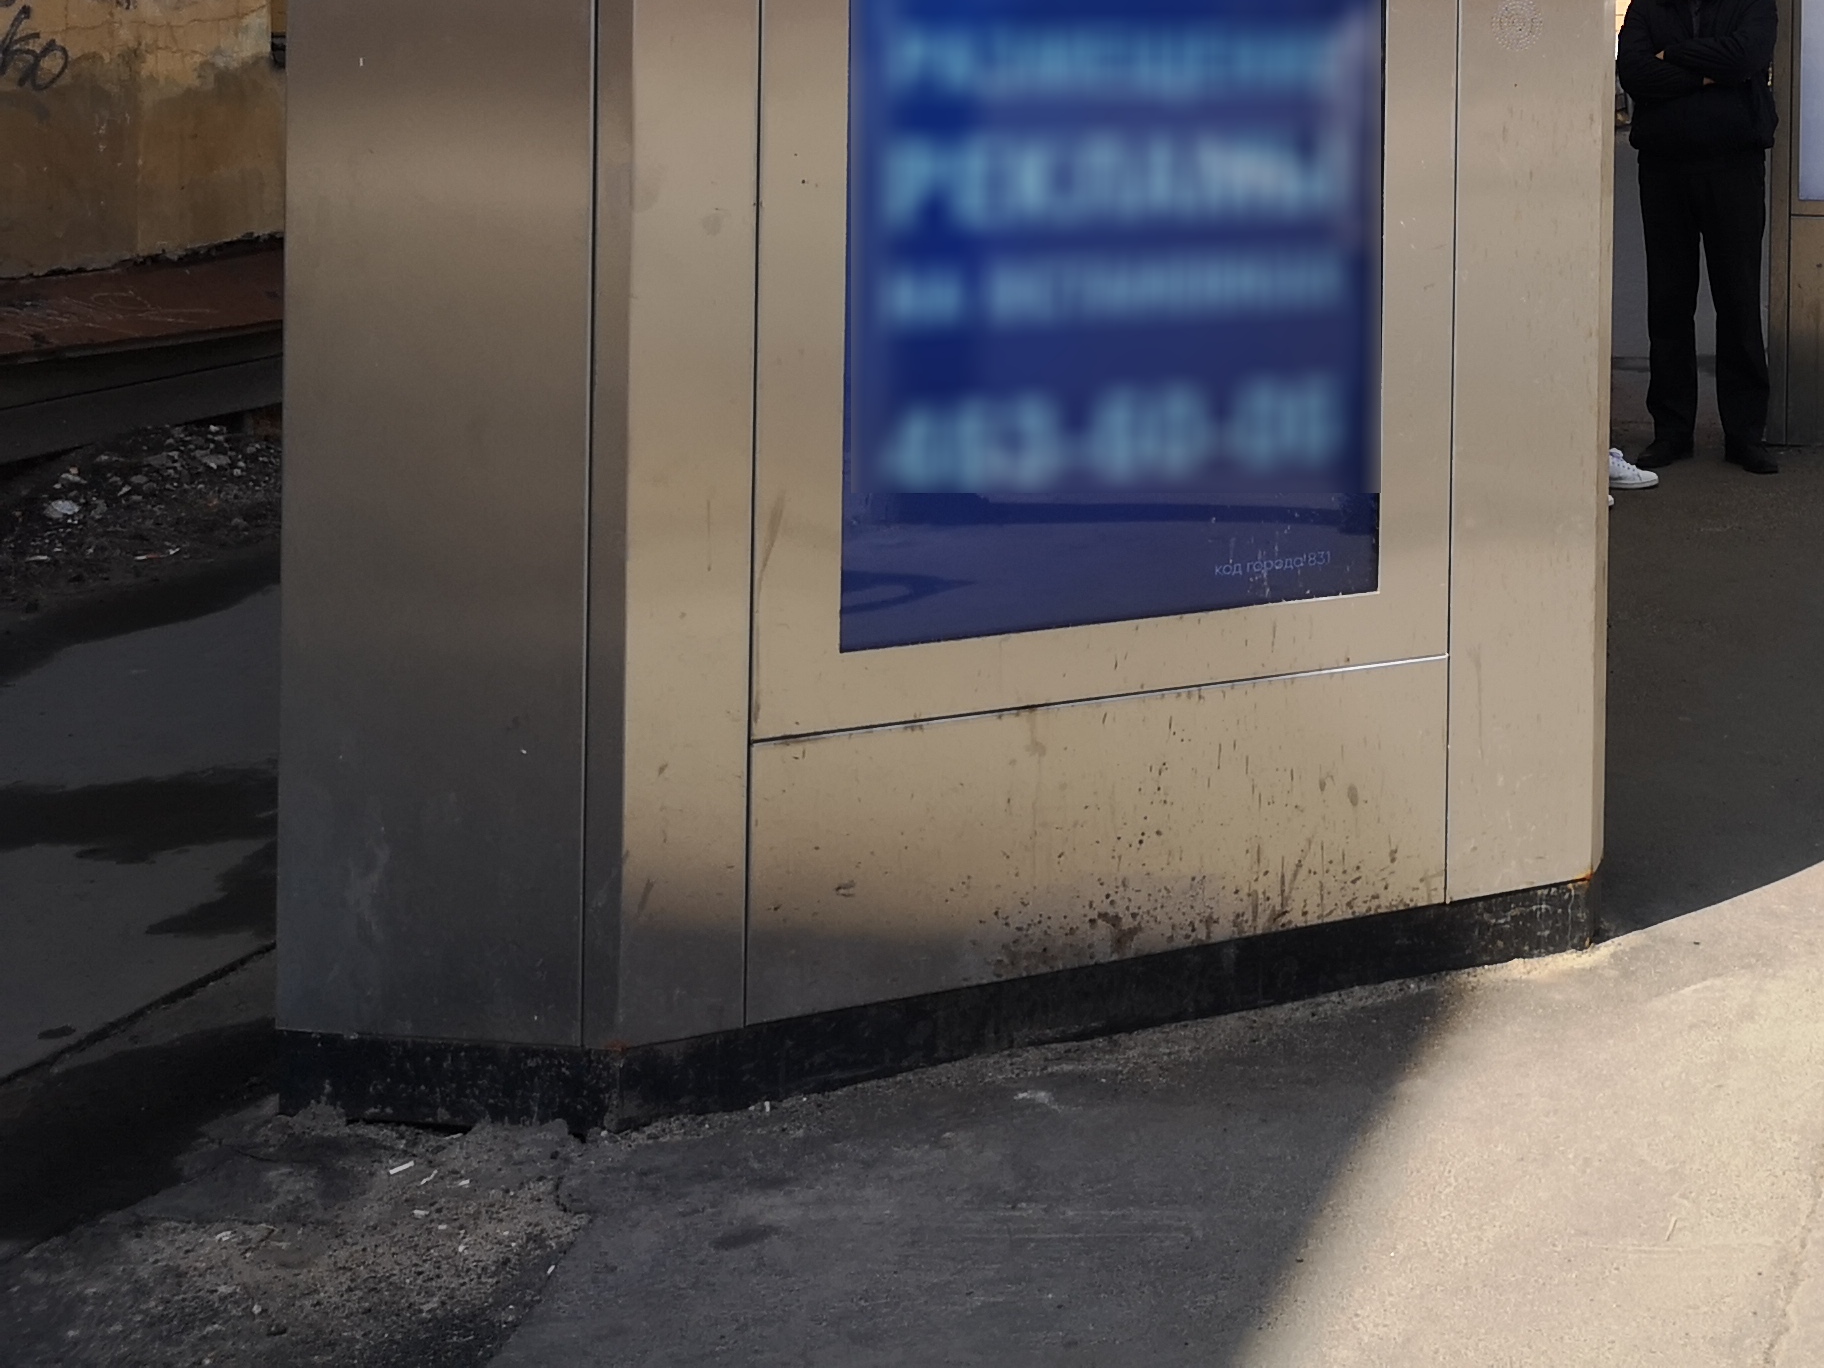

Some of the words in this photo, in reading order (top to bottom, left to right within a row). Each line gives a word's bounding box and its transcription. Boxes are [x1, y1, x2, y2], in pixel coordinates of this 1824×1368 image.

[1214, 563, 1243, 576] код
[1246, 556, 1304, 573] города
[1307, 549, 1331, 566] 831
